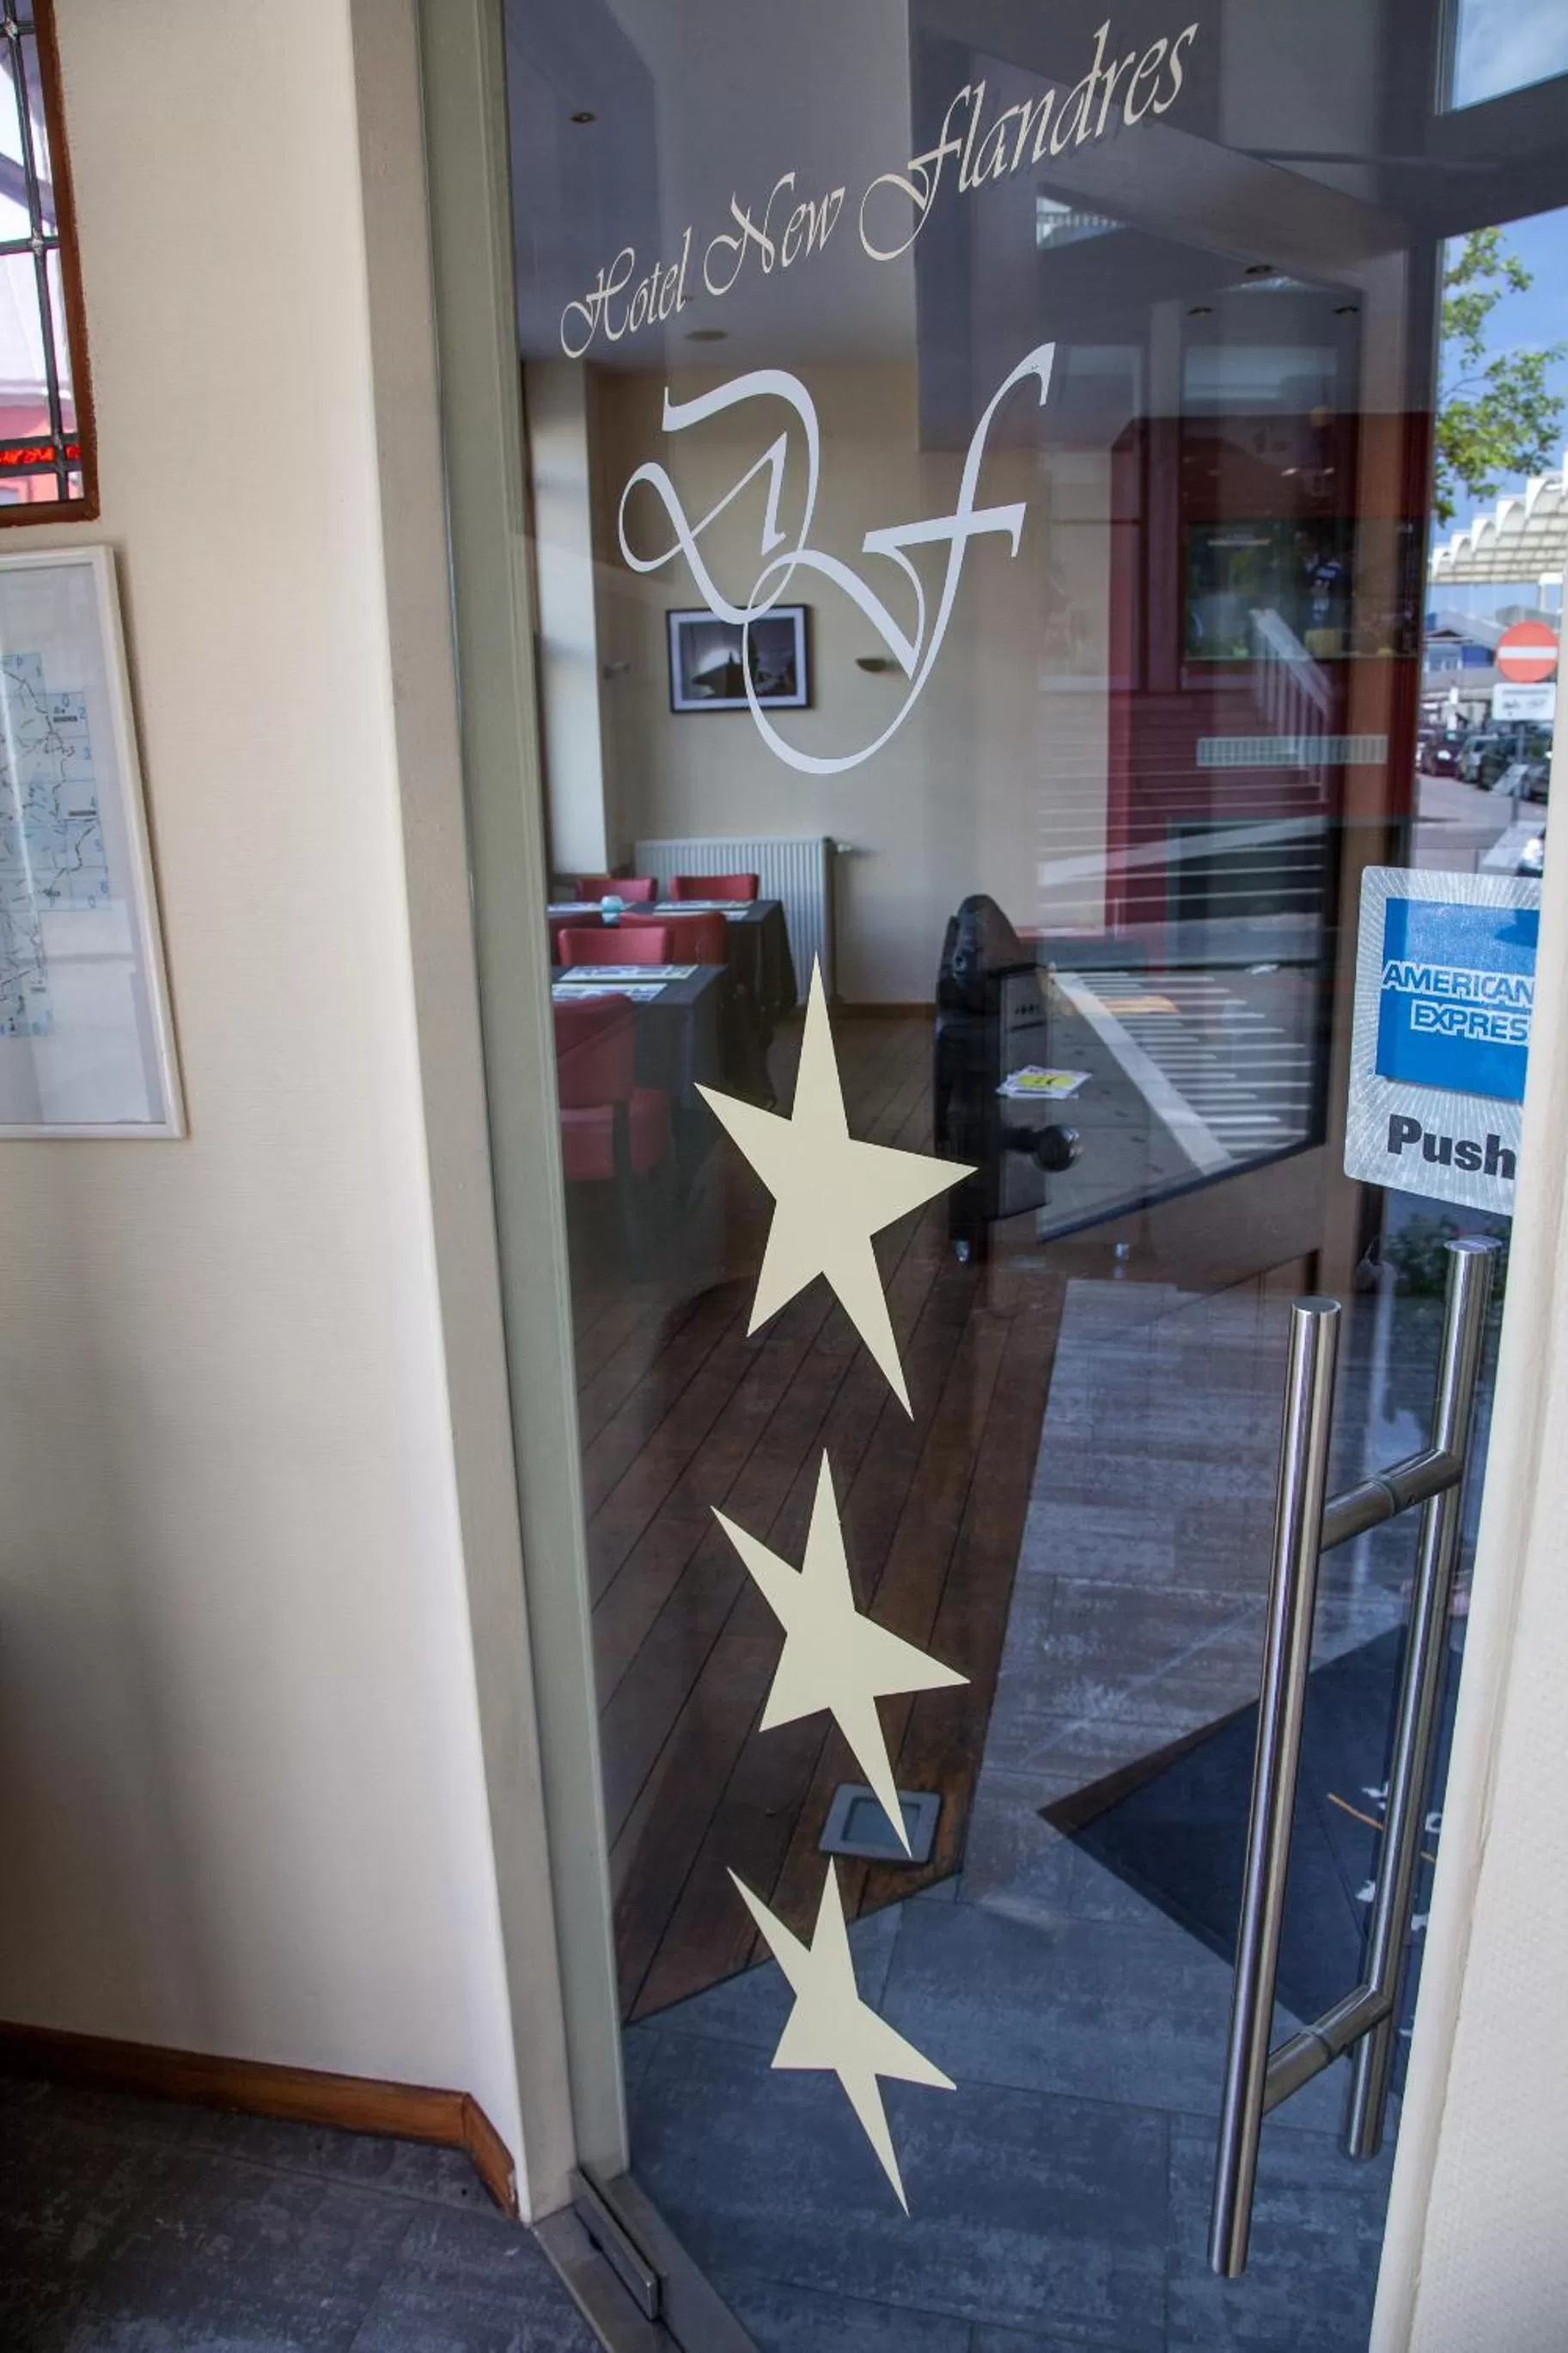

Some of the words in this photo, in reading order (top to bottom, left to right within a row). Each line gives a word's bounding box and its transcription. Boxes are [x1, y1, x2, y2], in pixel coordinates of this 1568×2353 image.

[559, 226, 692, 358] Hotel
[703, 172, 845, 296] New
[859, 19, 1199, 261] Flandres
[1382, 963, 1534, 1005] AMERICAN
[1414, 1005, 1528, 1042] EXPRES
[1387, 1113, 1516, 1180] Push
